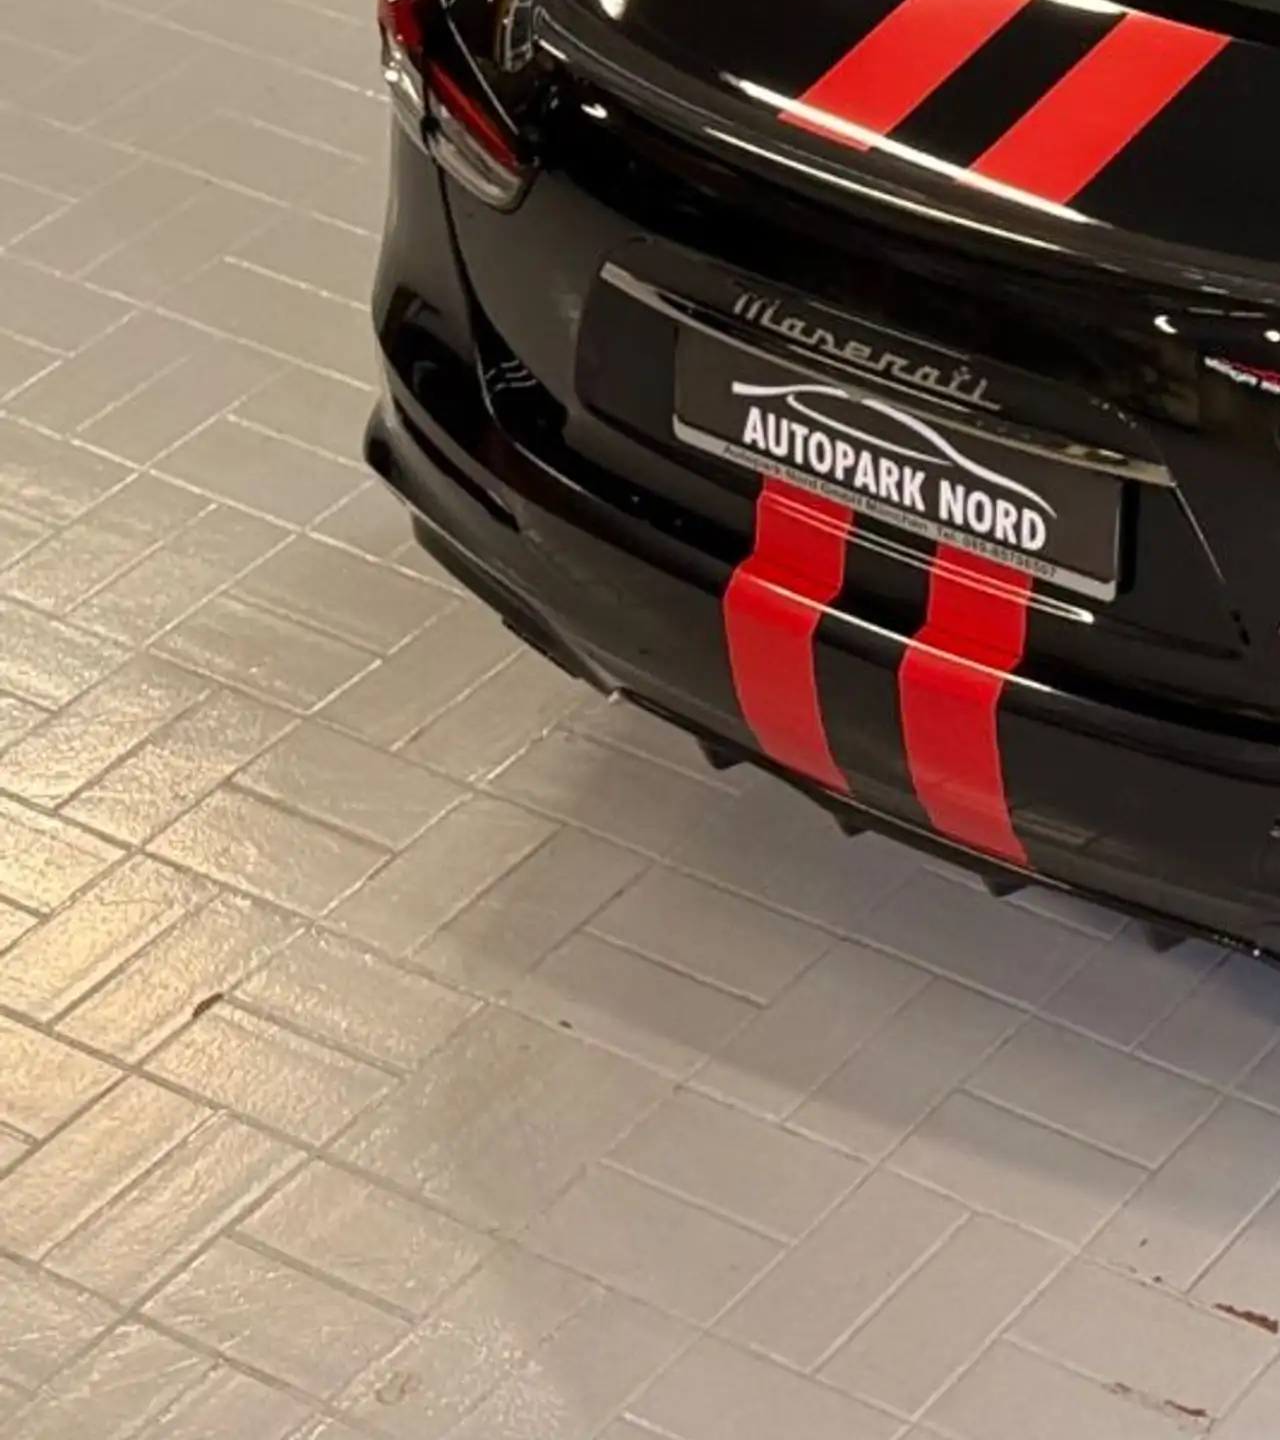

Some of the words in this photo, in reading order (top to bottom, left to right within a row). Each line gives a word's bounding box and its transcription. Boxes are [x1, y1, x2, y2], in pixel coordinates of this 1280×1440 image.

[734, 293, 1001, 410] Maserati
[742, 406, 926, 512] AUTOPARK
[938, 479, 1047, 550] NORD
